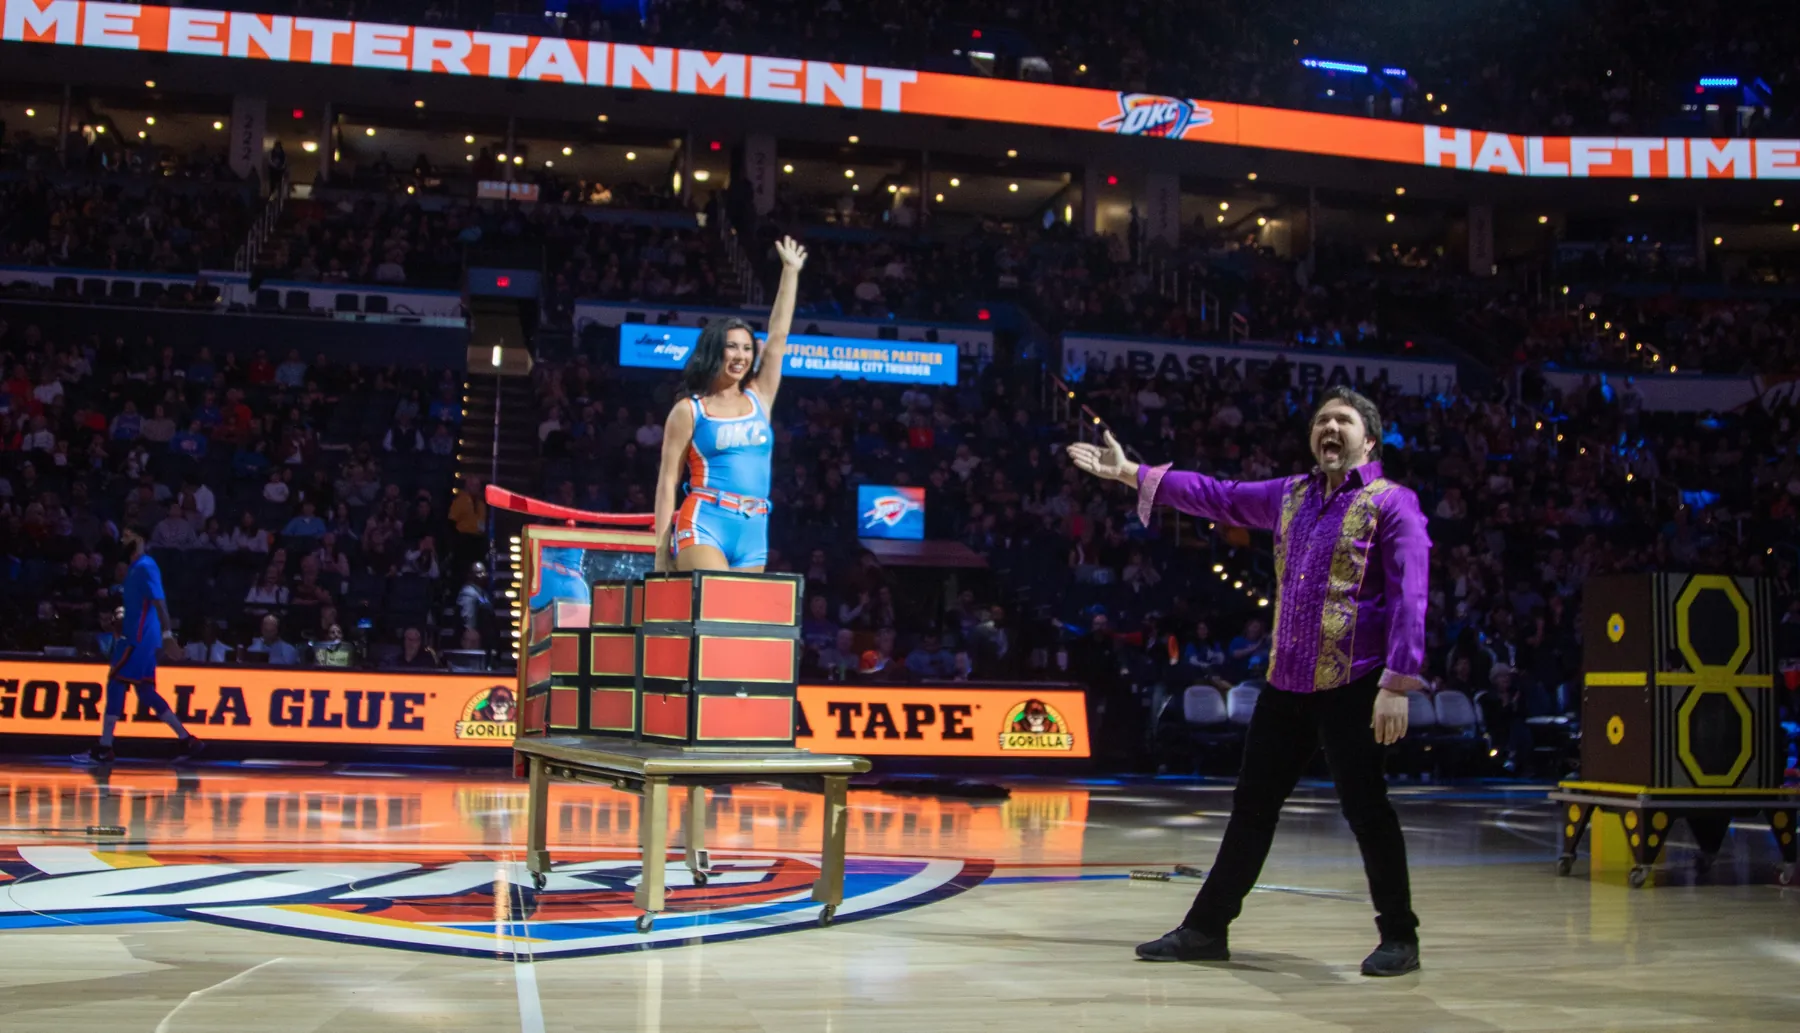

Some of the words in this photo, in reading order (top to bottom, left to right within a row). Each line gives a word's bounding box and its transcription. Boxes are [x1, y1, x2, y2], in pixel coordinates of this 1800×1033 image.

[2, 0, 142, 50] ME
[167, 7, 917, 111] ENTERTAINMENT
[1119, 101, 1180, 135] OKC
[1423, 125, 1800, 179] HALFTIME
[789, 357, 804, 369] OF
[805, 358, 860, 371] OKLAHOMA
[861, 361, 884, 372] CITY
[885, 362, 931, 375] THUNDER
[832, 346, 889, 362] CLEANING
[892, 350, 943, 365] PARTNER
[1128, 350, 1402, 394] BASKEBALL
[715, 421, 767, 450] OKC
[0, 679, 251, 725] GORLA
[466, 724, 516, 737] GORILL
[827, 702, 974, 741] TAPE
[1008, 736, 1065, 747] GORILLA
